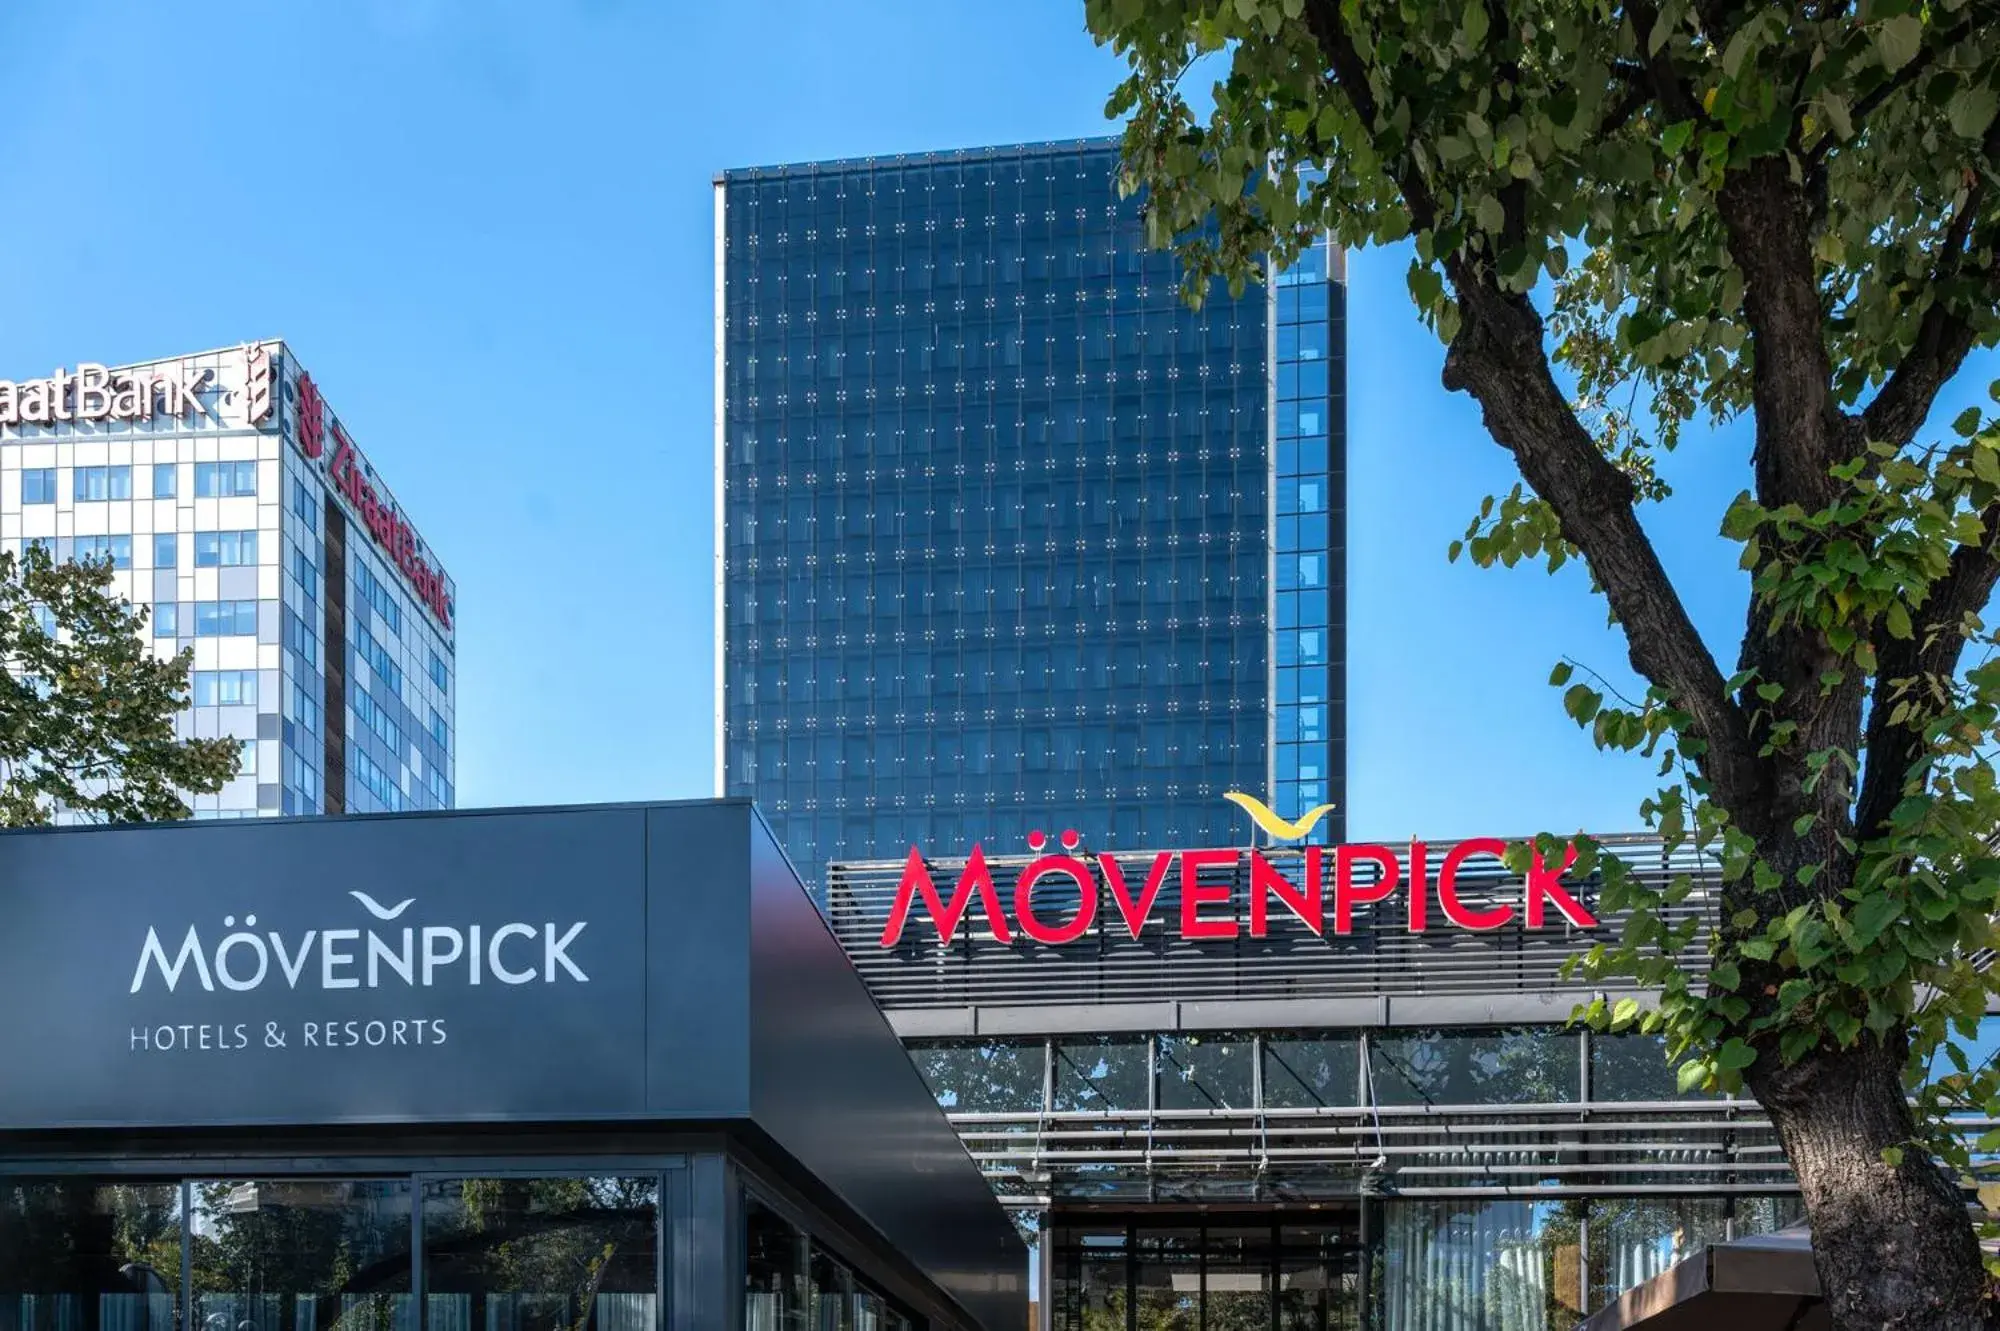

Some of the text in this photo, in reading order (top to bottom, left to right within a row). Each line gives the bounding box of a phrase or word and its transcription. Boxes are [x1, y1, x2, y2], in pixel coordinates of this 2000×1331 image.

[881, 829, 1599, 946] MÖVENPICK
[130, 914, 590, 993] MÖVENPICK
[131, 1019, 448, 1051] HOTELS & RESORTS
